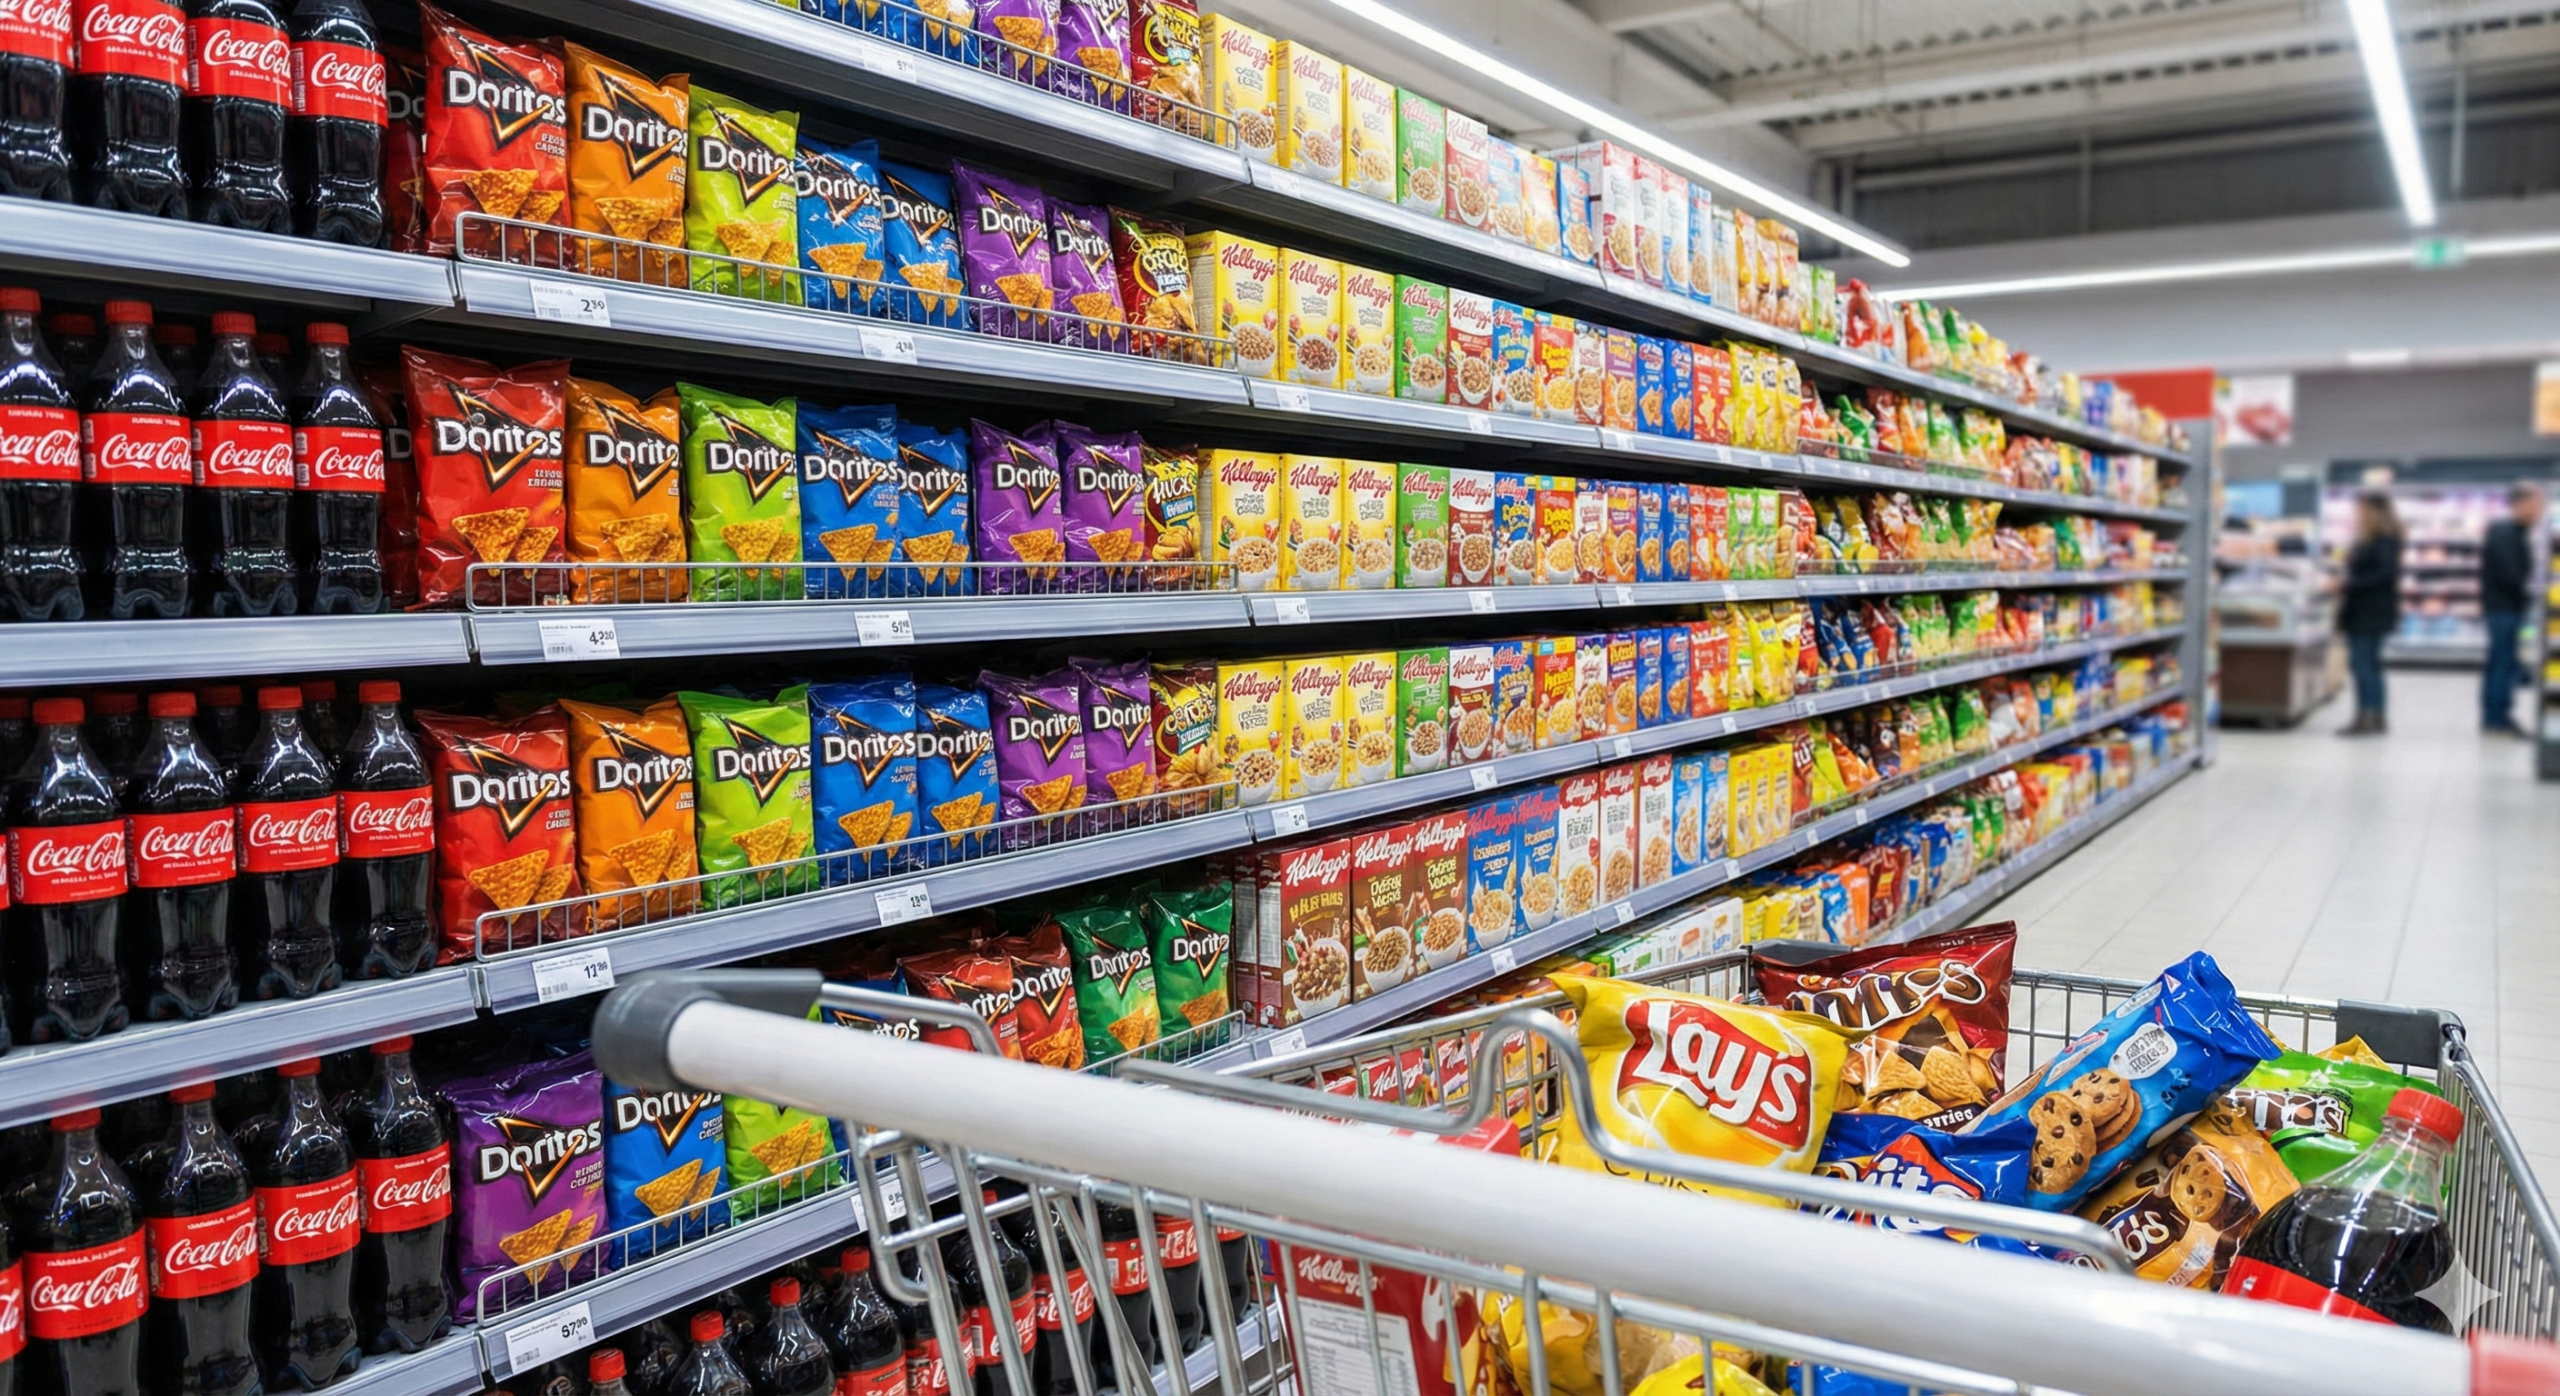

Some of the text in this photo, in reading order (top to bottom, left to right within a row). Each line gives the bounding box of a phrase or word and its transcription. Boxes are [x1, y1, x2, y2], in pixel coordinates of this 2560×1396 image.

[84, 4, 185, 54] Coca-Cola
[450, 69, 566, 127] Doritos
[1222, 245, 1276, 283] Kellogg's
[439, 420, 562, 458] Doritos
[804, 454, 898, 484] Doritos
[1222, 458, 1276, 491] Kellogg's
[1290, 464, 1340, 495] Kellogg's
[1349, 468, 1393, 498] Kellogg's
[1225, 671, 1281, 703] Kellogg's
[1291, 665, 1343, 697] Kellogg's
[1348, 661, 1394, 691] Kellogg's
[718, 745, 812, 779] Doritos
[824, 731, 915, 764] Doritos
[452, 770, 570, 808] Doritos
[1355, 831, 1413, 868] Kellogg's
[1416, 821, 1466, 849] Kellogg's
[1285, 852, 1351, 886] Kellogg's
[1090, 946, 1151, 980] Doritos
[1631, 1000, 1807, 1126] Lay's
[482, 1120, 601, 1182] Doritos
[31, 1256, 140, 1314] Coca-Cola
